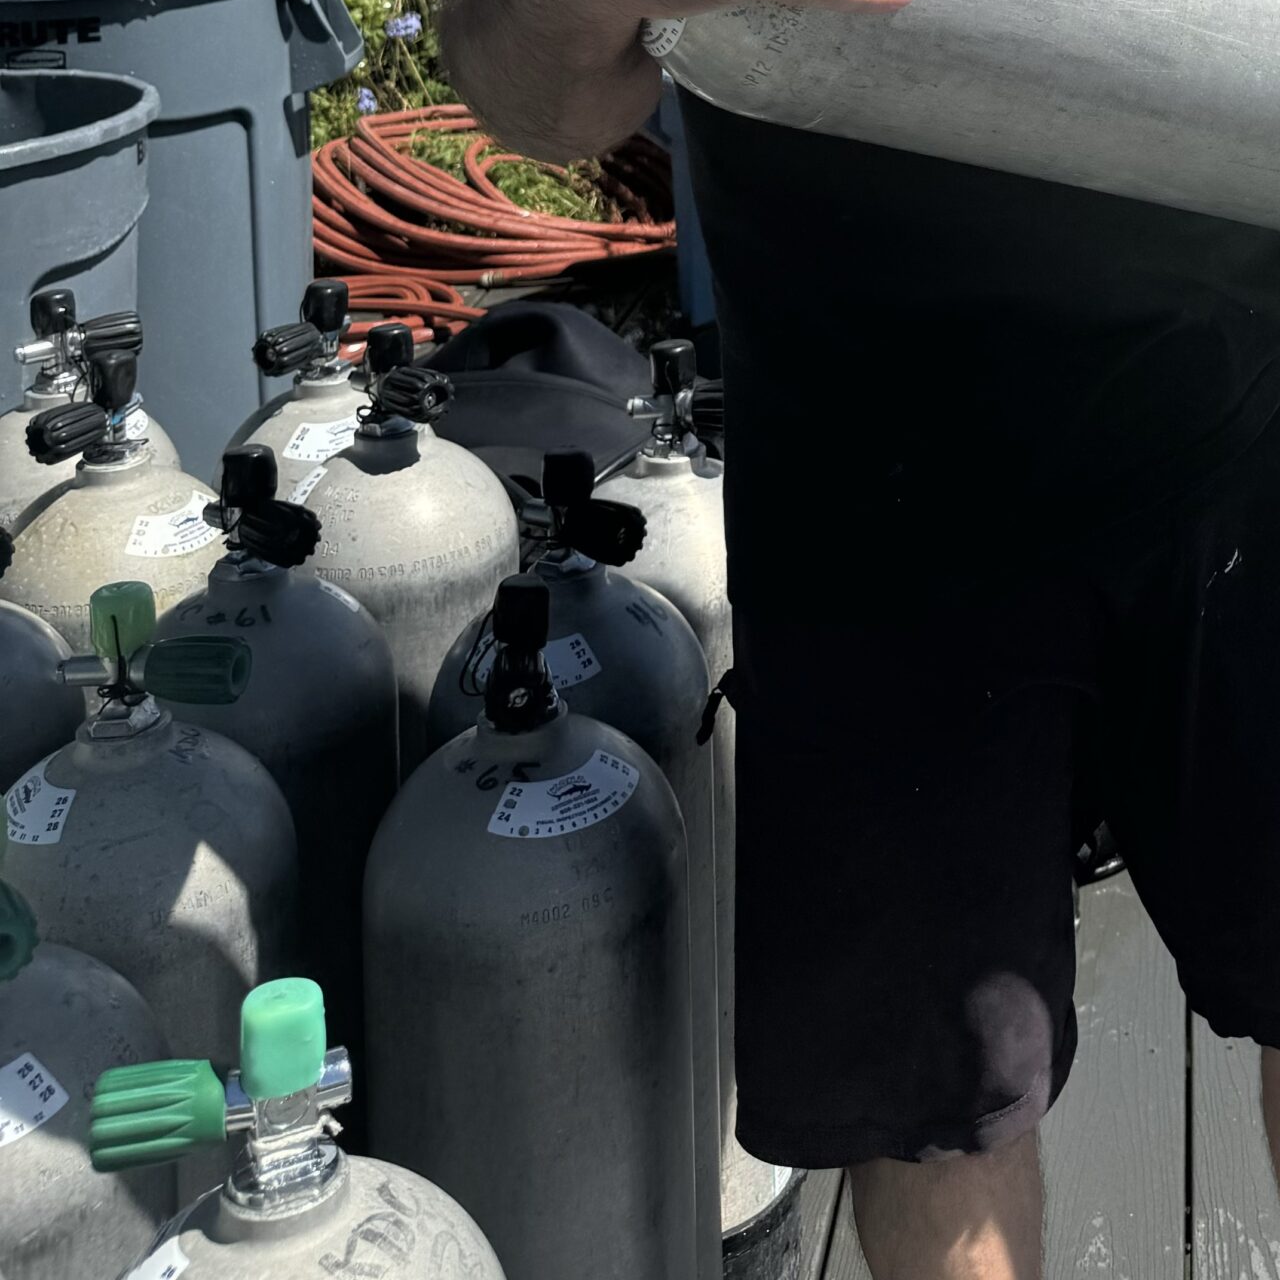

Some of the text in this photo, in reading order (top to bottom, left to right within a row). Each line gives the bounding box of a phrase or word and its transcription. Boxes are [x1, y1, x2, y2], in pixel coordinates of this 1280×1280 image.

[574, 647, 587, 660] 27
[509, 786, 524, 797] 22
[55, 796, 69, 806] 26
[50, 808, 64, 819] 27
[497, 811, 511, 823] 24
[45, 821, 60, 832] 28
[17, 1062, 34, 1079] 26
[28, 1072, 44, 1091] 27
[39, 1084, 56, 1102] 28
